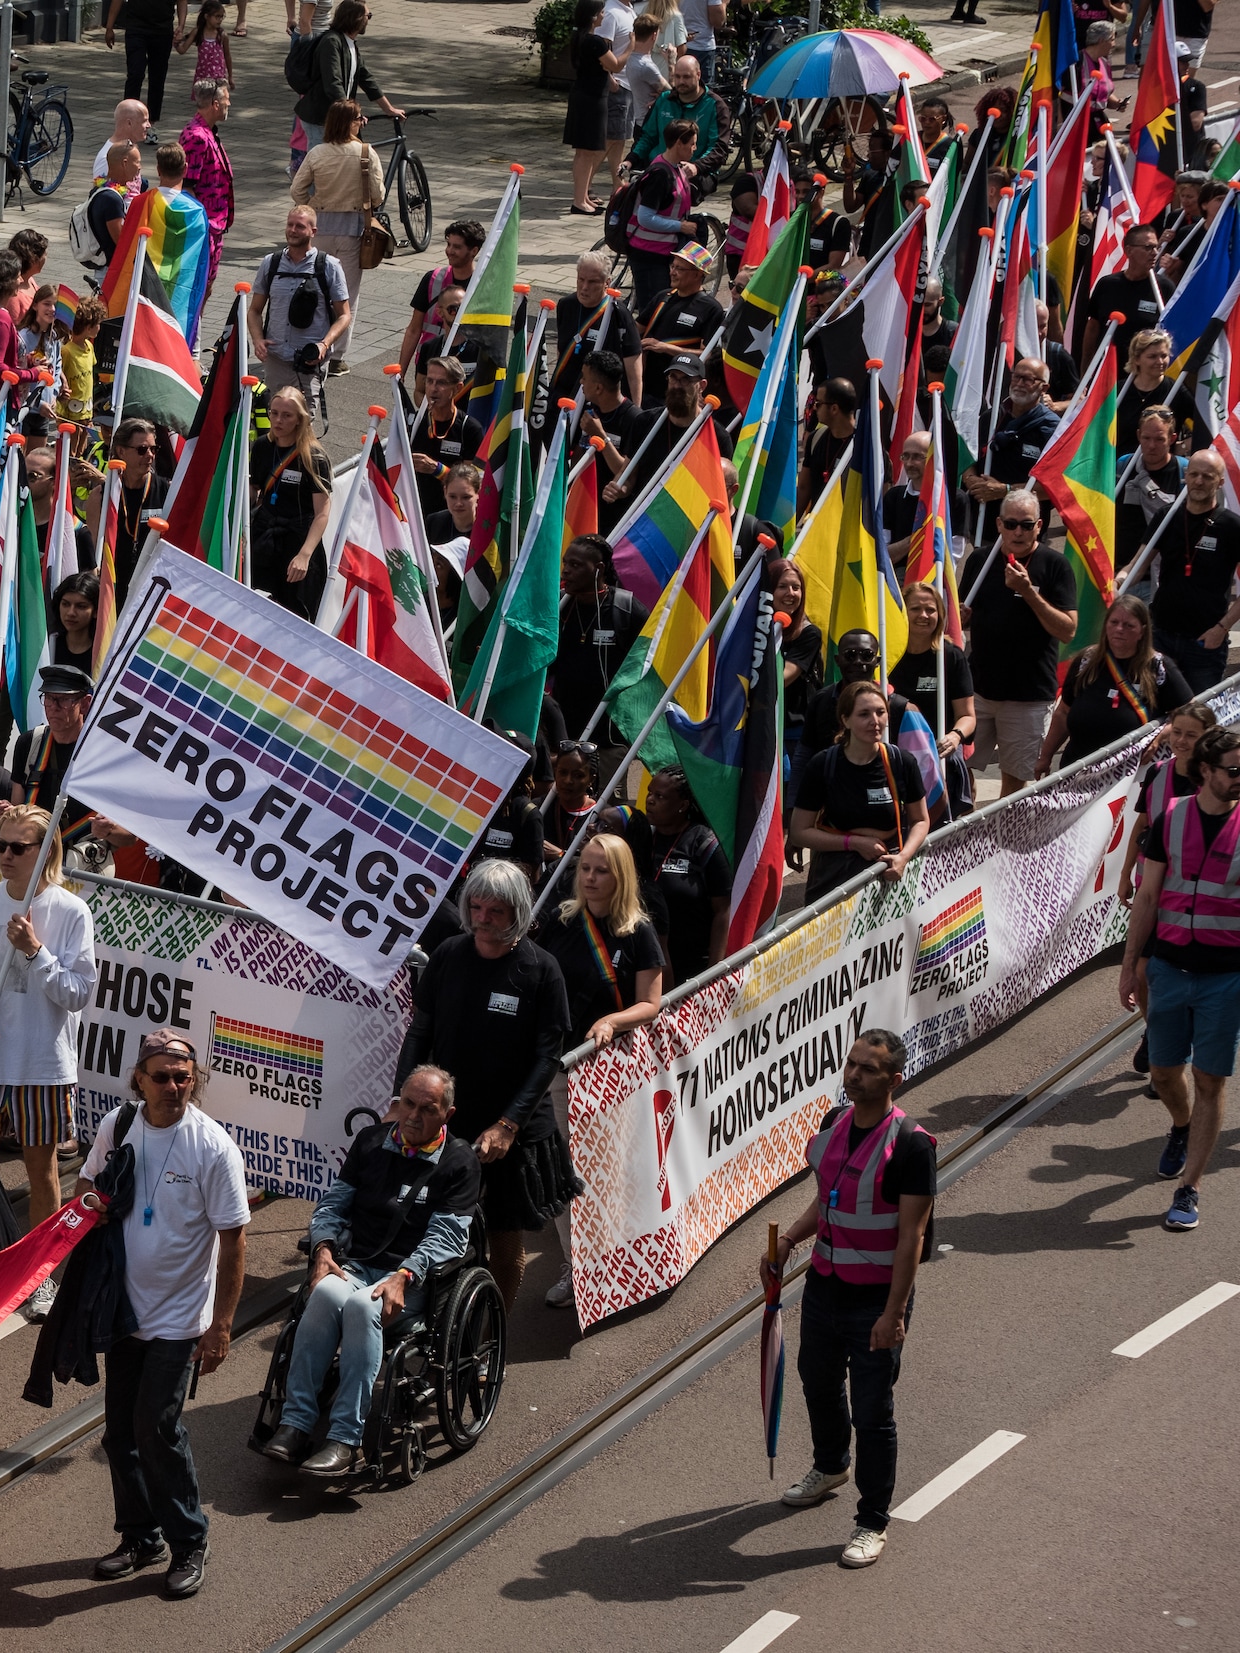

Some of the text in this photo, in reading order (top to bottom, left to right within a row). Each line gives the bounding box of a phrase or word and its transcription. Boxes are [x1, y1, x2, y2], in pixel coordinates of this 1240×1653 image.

[96, 691, 437, 919] ZERO FLAGS
[186, 802, 415, 956] PROJECT
[910, 938, 989, 996] ZERO FLAGS
[937, 961, 989, 1001] PROJECT
[676, 1065, 699, 1117] 71
[704, 1012, 772, 1100] NATIONS
[776, 932, 905, 1045] CRIMINAZING
[210, 1055, 323, 1095] ZERO FLAGS
[249, 1082, 322, 1110] PROJECT
[588, 1054, 609, 1101] THIS
[235, 1125, 269, 1152] THIS
[274, 1135, 289, 1156] IS
[286, 1159, 324, 1185] THIS
